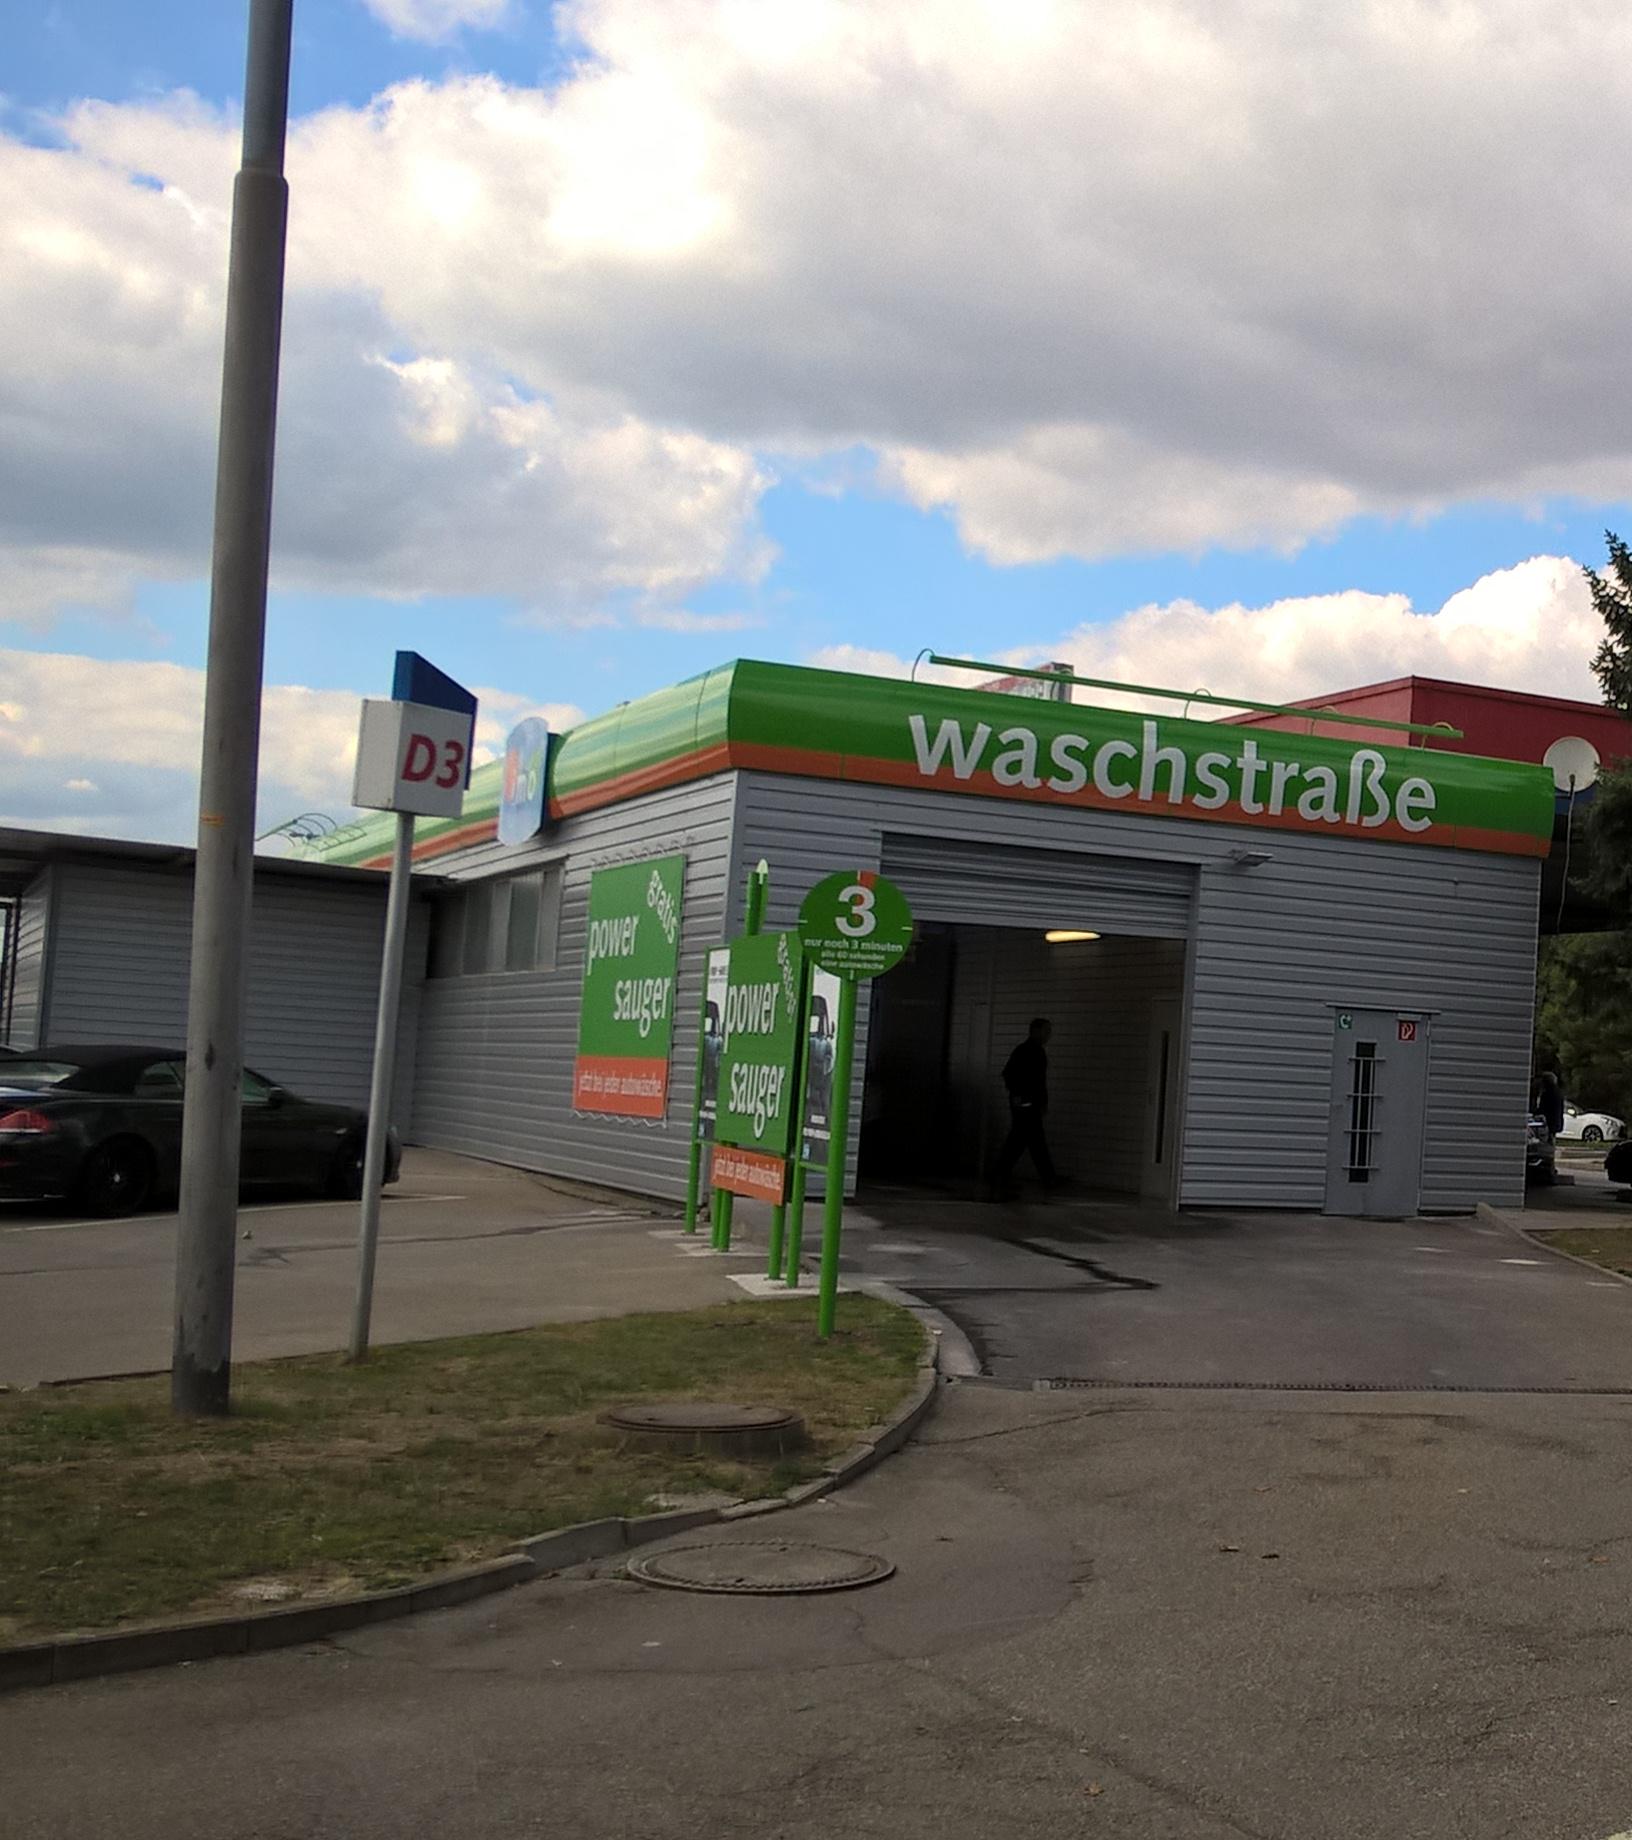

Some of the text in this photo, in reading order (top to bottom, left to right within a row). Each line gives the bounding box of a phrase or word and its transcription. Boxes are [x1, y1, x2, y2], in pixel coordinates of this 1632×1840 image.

[401, 733, 465, 790] D3
[908, 714, 1437, 833] waschstraße
[835, 885, 877, 938] 3
[587, 915, 640, 977] power
[804, 938, 903, 953] nur noch 3 minuten
[613, 976, 671, 1038] sauger
[724, 981, 780, 1054] power
[729, 1062, 786, 1139] sauger
